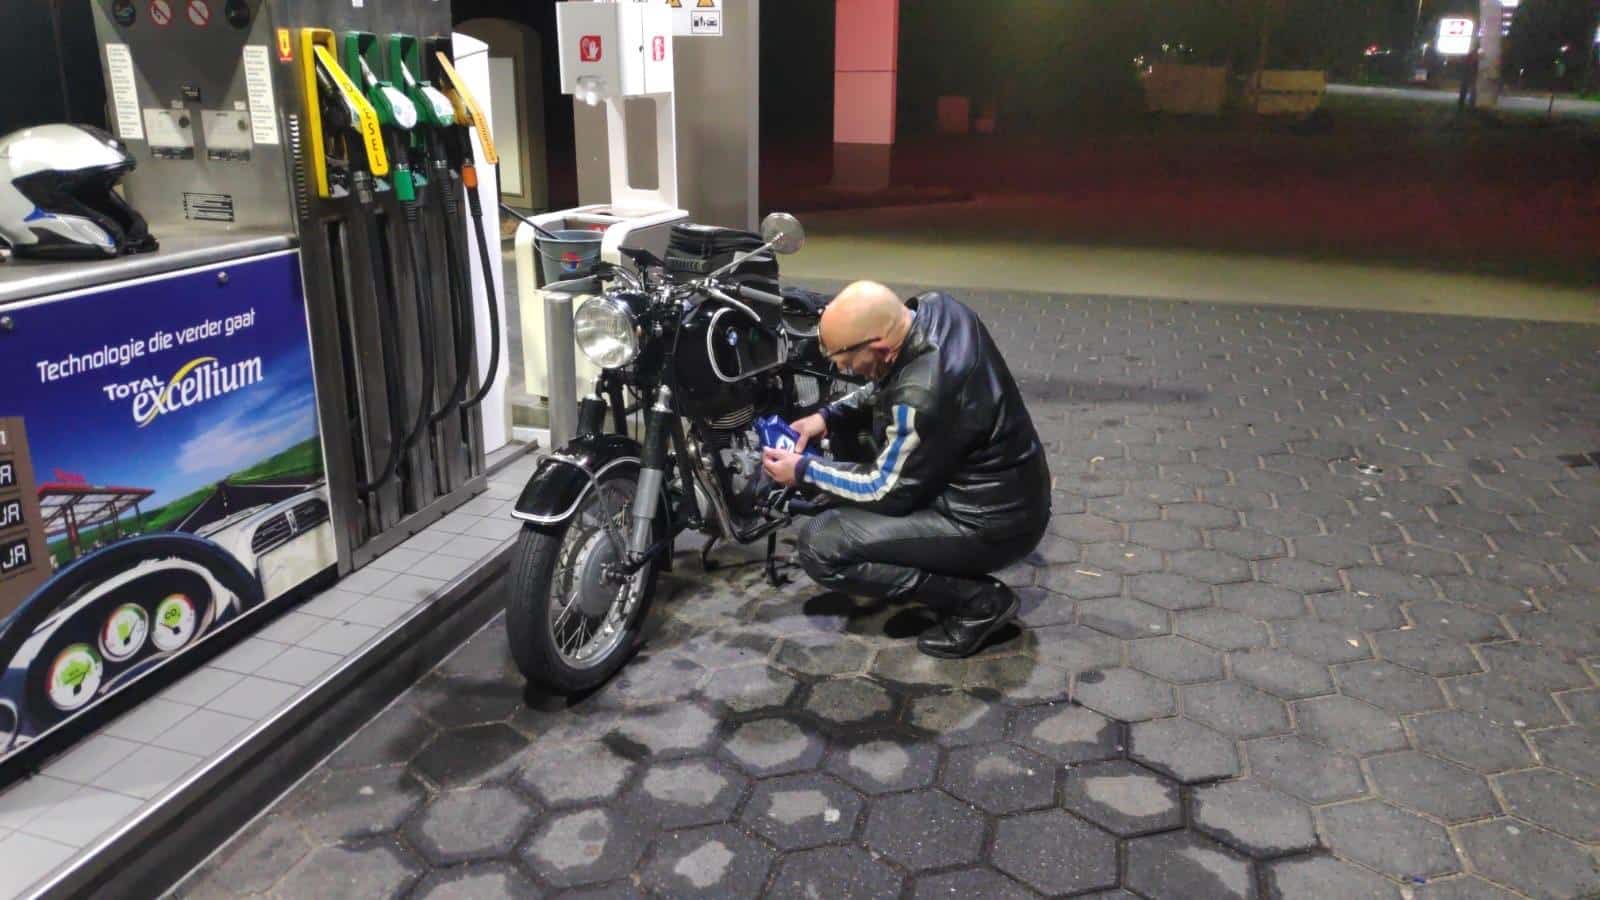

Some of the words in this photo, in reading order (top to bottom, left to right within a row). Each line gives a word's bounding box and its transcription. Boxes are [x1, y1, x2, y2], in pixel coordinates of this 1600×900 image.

[36, 338, 145, 383] Technologie
[148, 331, 173, 353] die
[175, 319, 222, 345] verder
[225, 308, 256, 336] gaat
[103, 374, 166, 401] TOTAL
[132, 356, 264, 423] excellium
[3, 544, 26, 569] JA
